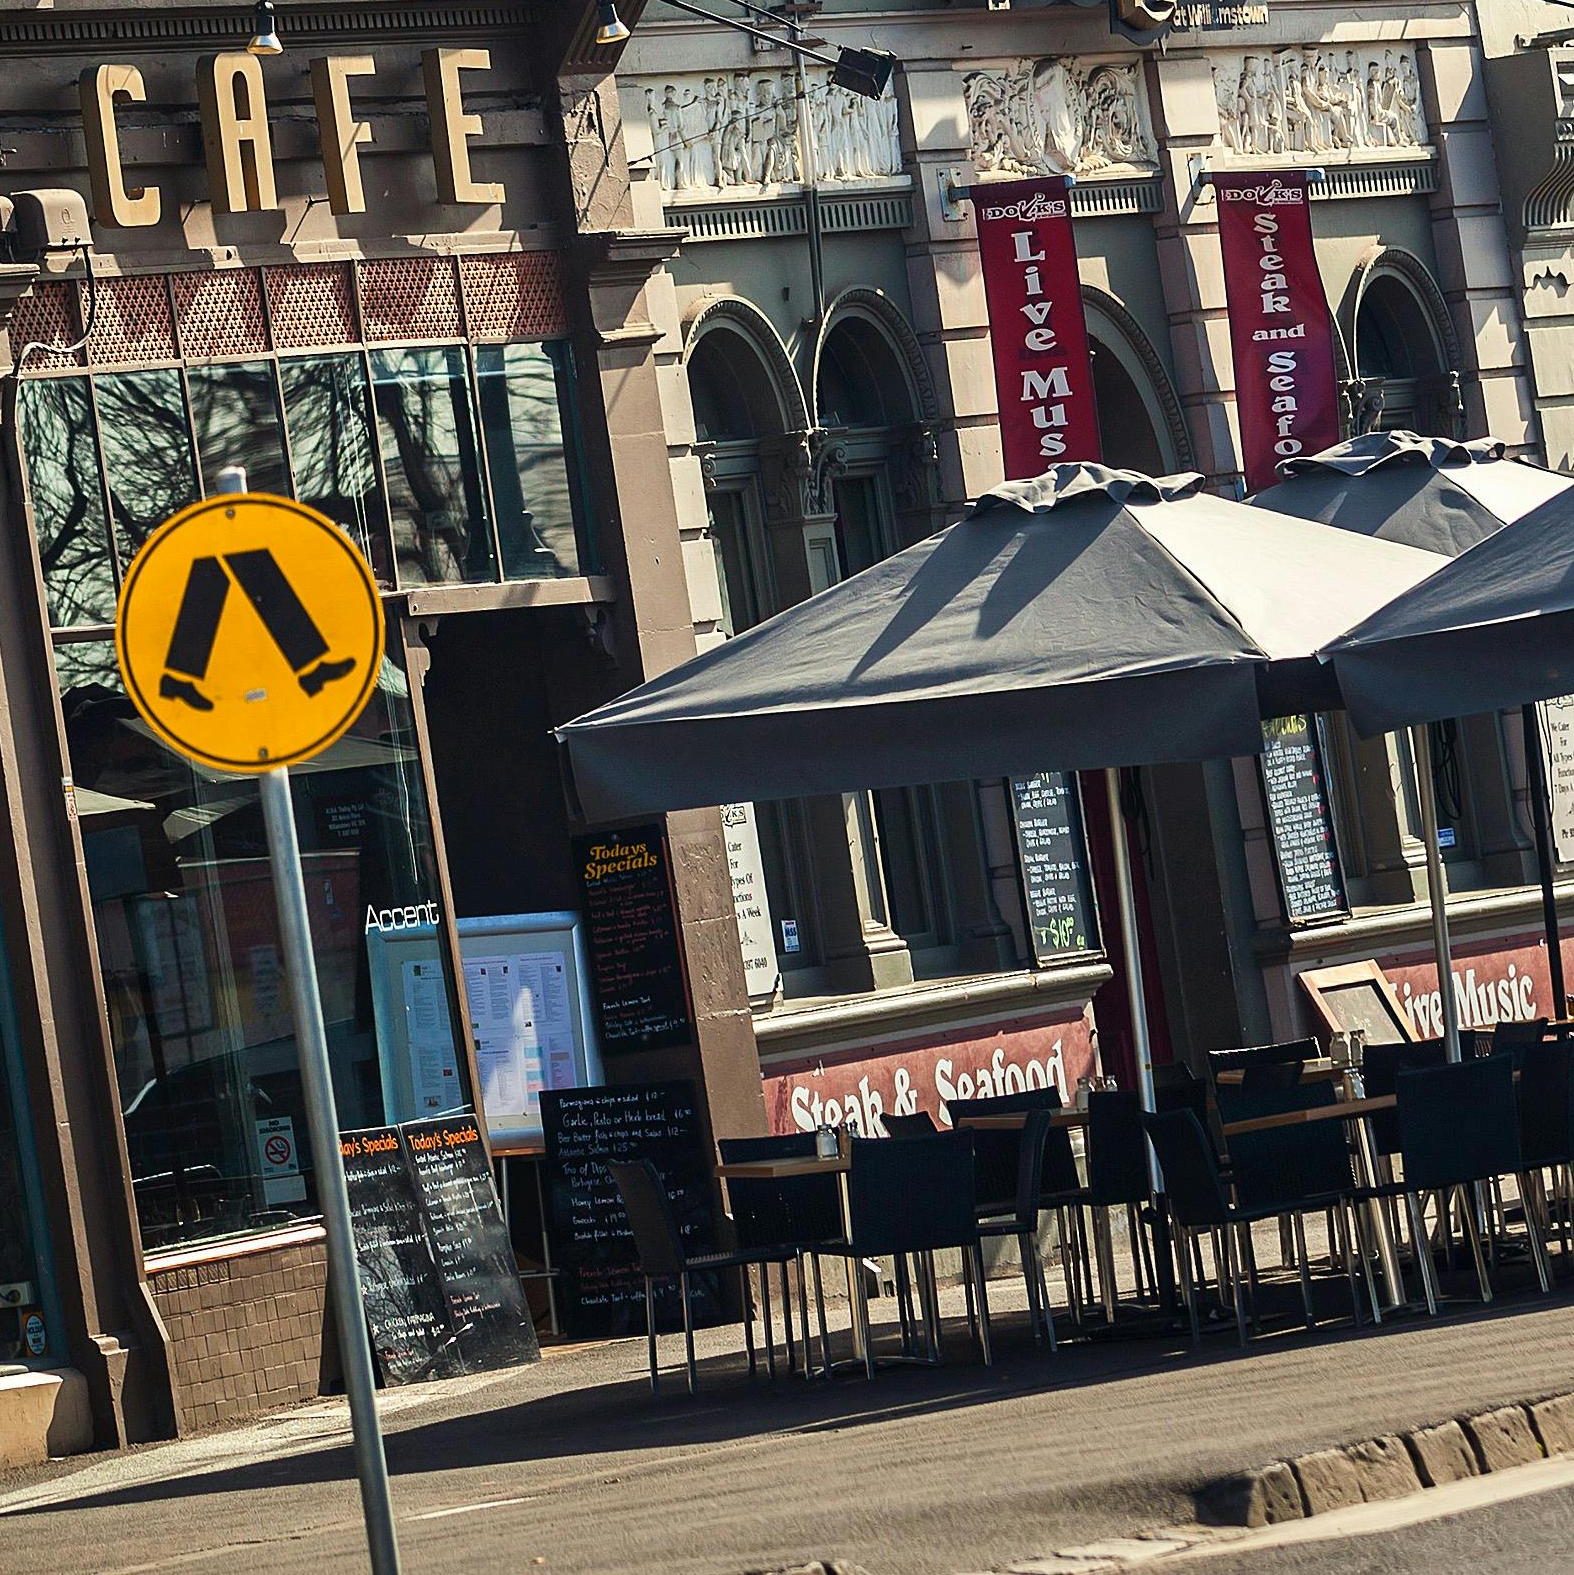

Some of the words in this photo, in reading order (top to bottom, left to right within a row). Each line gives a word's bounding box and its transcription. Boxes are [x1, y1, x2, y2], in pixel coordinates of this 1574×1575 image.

[1175, 8, 1187, 26] at
[81, 48, 507, 228] CAFE
[1253, 212, 1291, 314] Steak
[1011, 231, 1057, 351] Live
[1252, 323, 1306, 341] and
[590, 841, 646, 861] Todays
[727, 841, 742, 852] Cater
[584, 852, 657, 880] Specials
[730, 858, 739, 869] For
[746, 872, 754, 884] Of
[365, 900, 439, 935] Accent
[747, 906, 762, 918] Week
[754, 957, 768, 968] 6040
[1453, 963, 1537, 1028] Music
[791, 1075, 891, 1138] Steak
[894, 1067, 919, 1117] &
[934, 1038, 1070, 1126] Seafood
[362, 1132, 399, 1155] Specials
[408, 1130, 442, 1152] Today's
[442, 1125, 479, 1149] Specials
